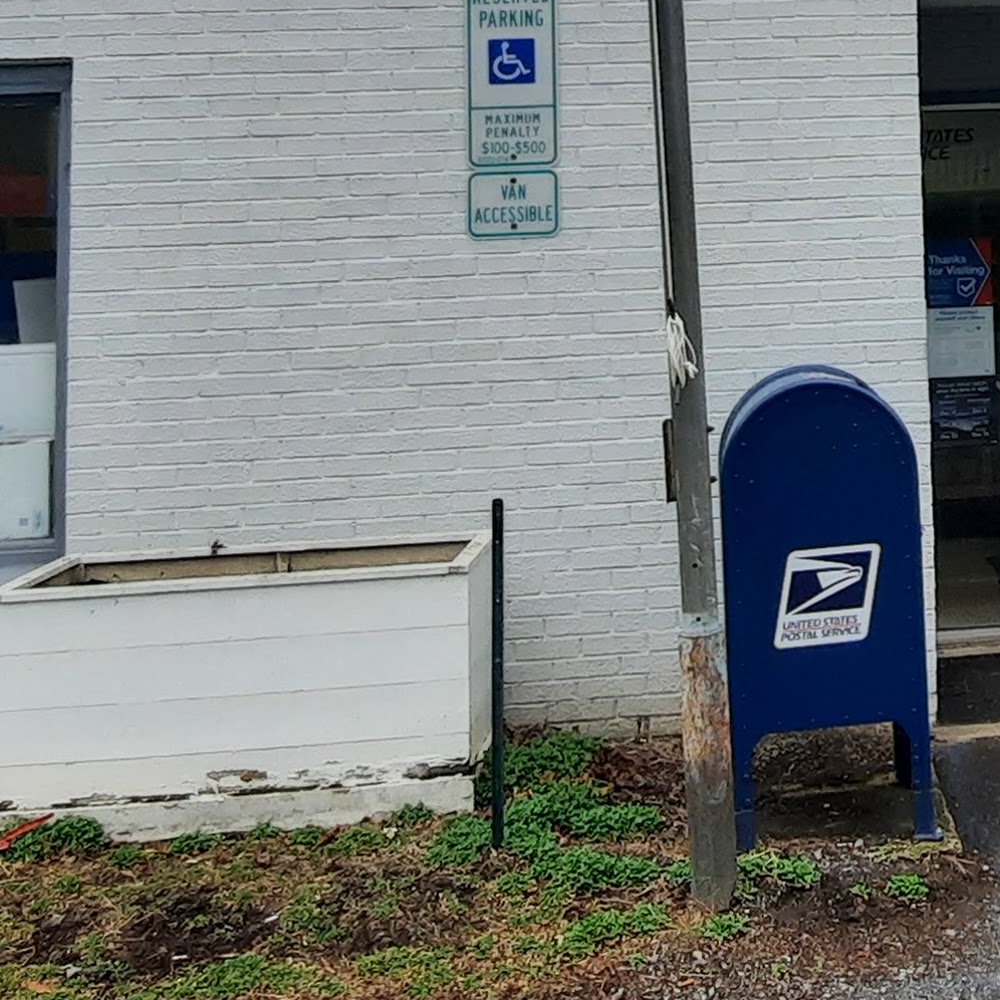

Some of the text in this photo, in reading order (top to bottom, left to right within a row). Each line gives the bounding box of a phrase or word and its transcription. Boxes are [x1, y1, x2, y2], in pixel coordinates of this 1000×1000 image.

[479, 9, 544, 28] PARKING
[485, 113, 541, 125] MAXIMUM
[486, 125, 540, 138] PENALTY
[482, 141, 546, 154] $100-$500
[501, 184, 526, 200] VAN
[475, 205, 553, 224] ACCESSIBLE
[928, 254, 967, 265] Thanks
[928, 264, 986, 277] for Visiting
[782, 615, 858, 630] UNITED STATES
[781, 626, 861, 642] POSTAL SERVICE
